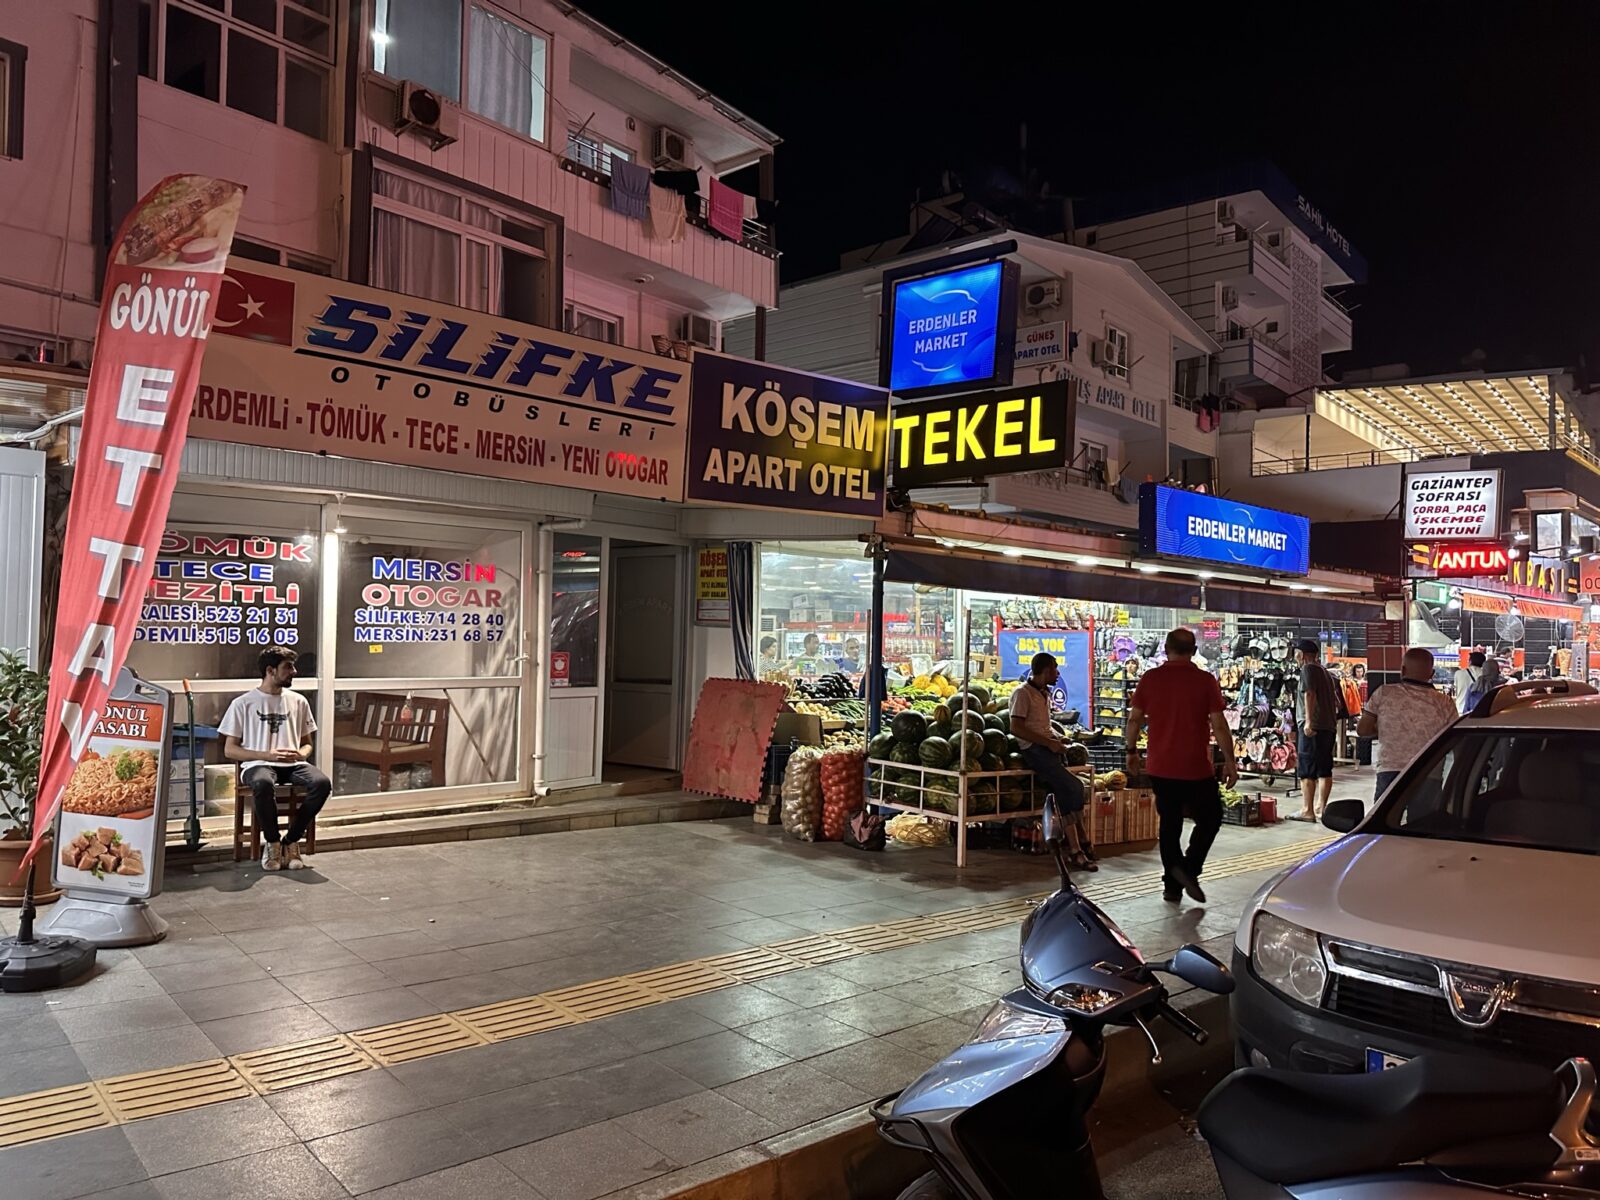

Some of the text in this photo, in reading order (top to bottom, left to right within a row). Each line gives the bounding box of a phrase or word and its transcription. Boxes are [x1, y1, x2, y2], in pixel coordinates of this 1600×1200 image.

[1326, 221, 1351, 257] HOTEL
[109, 273, 212, 340] GÖNÜL
[908, 309, 978, 335] ERDENLER
[914, 332, 968, 354] MARKET
[1040, 343, 1061, 356] OTEL
[721, 380, 875, 452] KÖŞEM
[306, 397, 387, 445] TÖMÜK
[405, 417, 459, 455] TECE
[605, 450, 669, 486] OTOGAR
[892, 396, 1056, 469] TEKEL
[702, 447, 876, 500] APART OTEL
[1411, 476, 1493, 491] GAZİANTEP
[1416, 490, 1482, 502] SOFRASI
[1414, 515, 1485, 525] İŞKEMBE
[1419, 524, 1482, 535] TANTUNİ
[1187, 516, 1287, 551] ERDENLER MARKET
[159, 530, 312, 562] ÖMÜK
[155, 560, 274, 582] TECE
[372, 556, 496, 584] MERSİN
[361, 583, 503, 608] OTOGAR
[246, 607, 270, 624] 21
[275, 608, 299, 625] 31
[462, 613, 481, 626] 28
[485, 613, 504, 626] 40
[247, 627, 270, 645] 16
[274, 628, 299, 645] 05
[463, 629, 481, 642] 68
[486, 629, 504, 642] 57
[1041, 637, 1066, 652] YOK
[94, 720, 148, 737] ASABI
